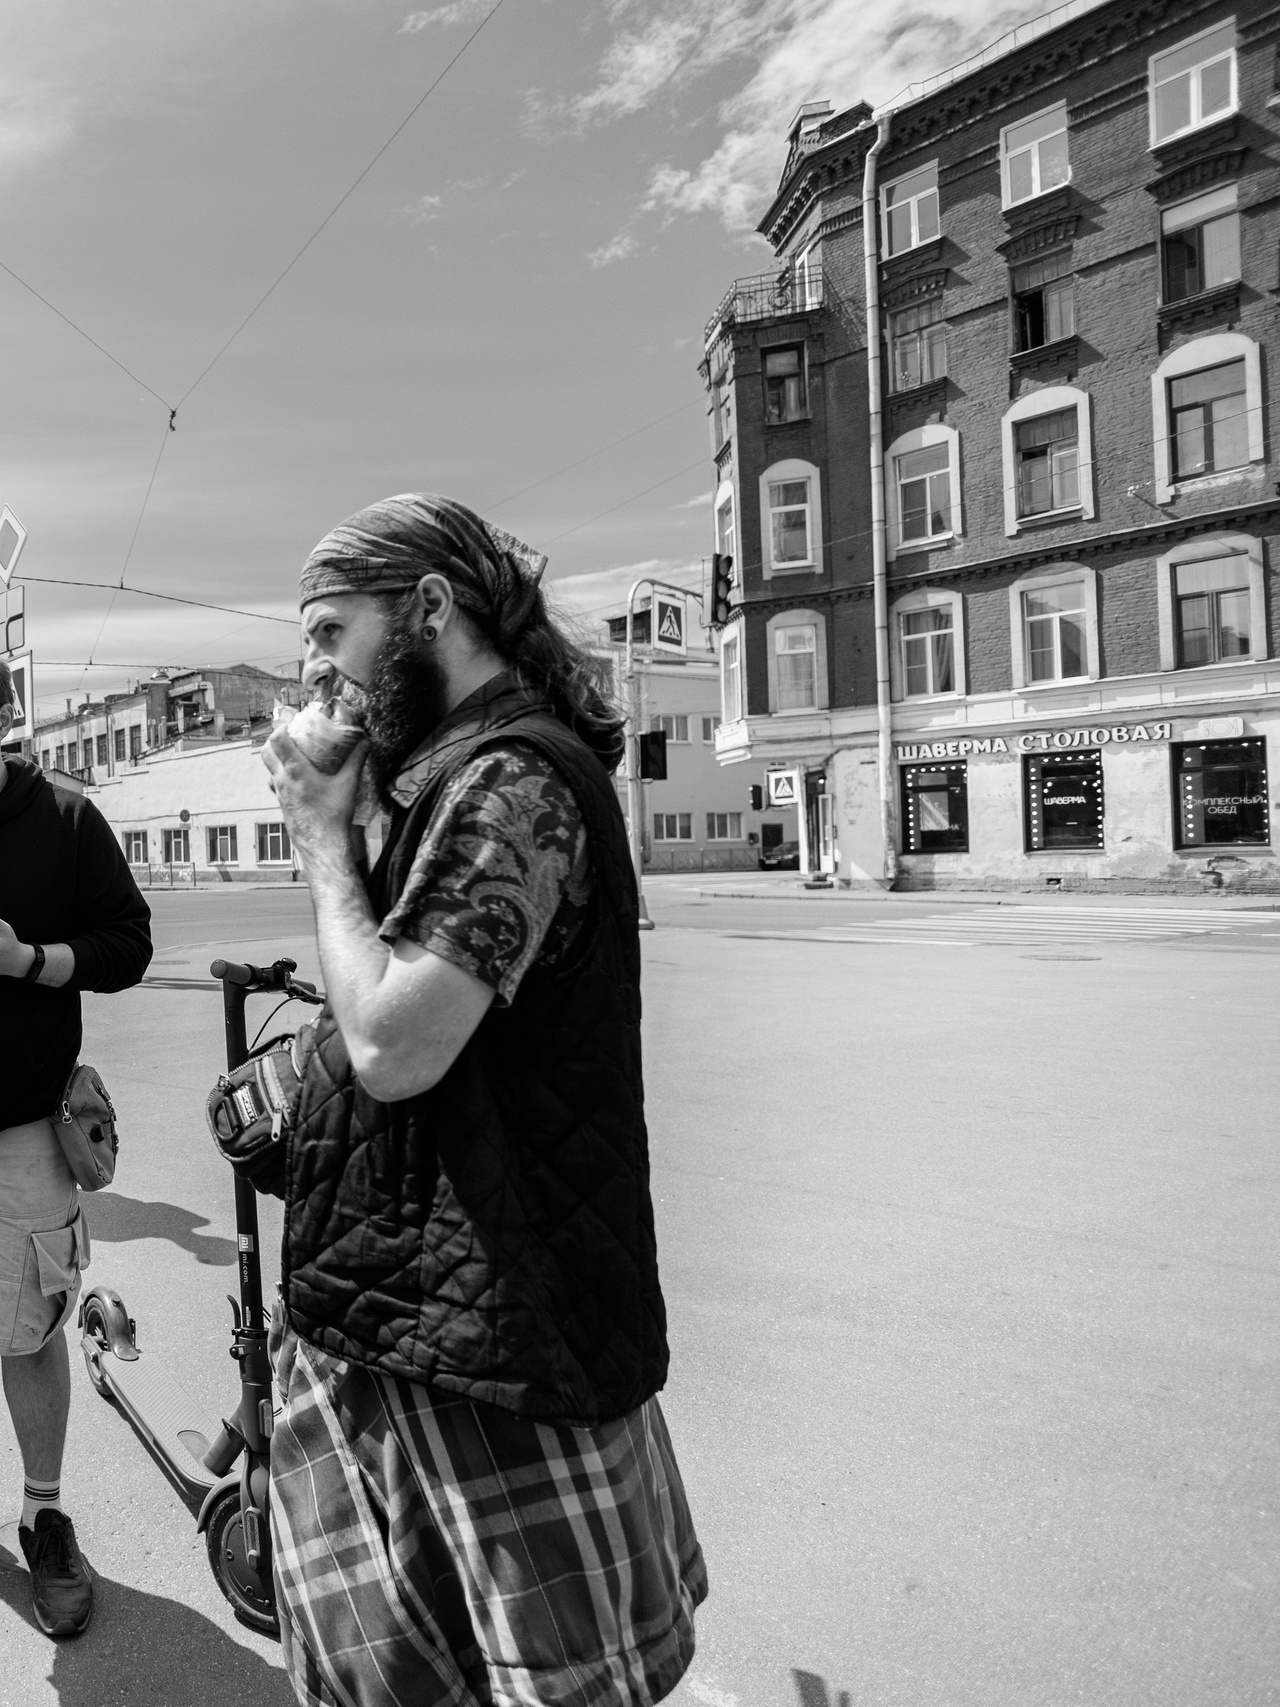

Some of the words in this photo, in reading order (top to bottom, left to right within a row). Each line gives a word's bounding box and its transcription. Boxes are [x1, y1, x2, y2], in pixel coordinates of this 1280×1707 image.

[897, 738, 1008, 760] ШАВЕРМА
[1018, 723, 1172, 750] СТОЛОВАЯ
[1044, 796, 1087, 805] ШАВЕРМА
[1183, 794, 1263, 806] КОМПЛЕКСНЫЙ
[1208, 805, 1237, 815] ОБЕД
